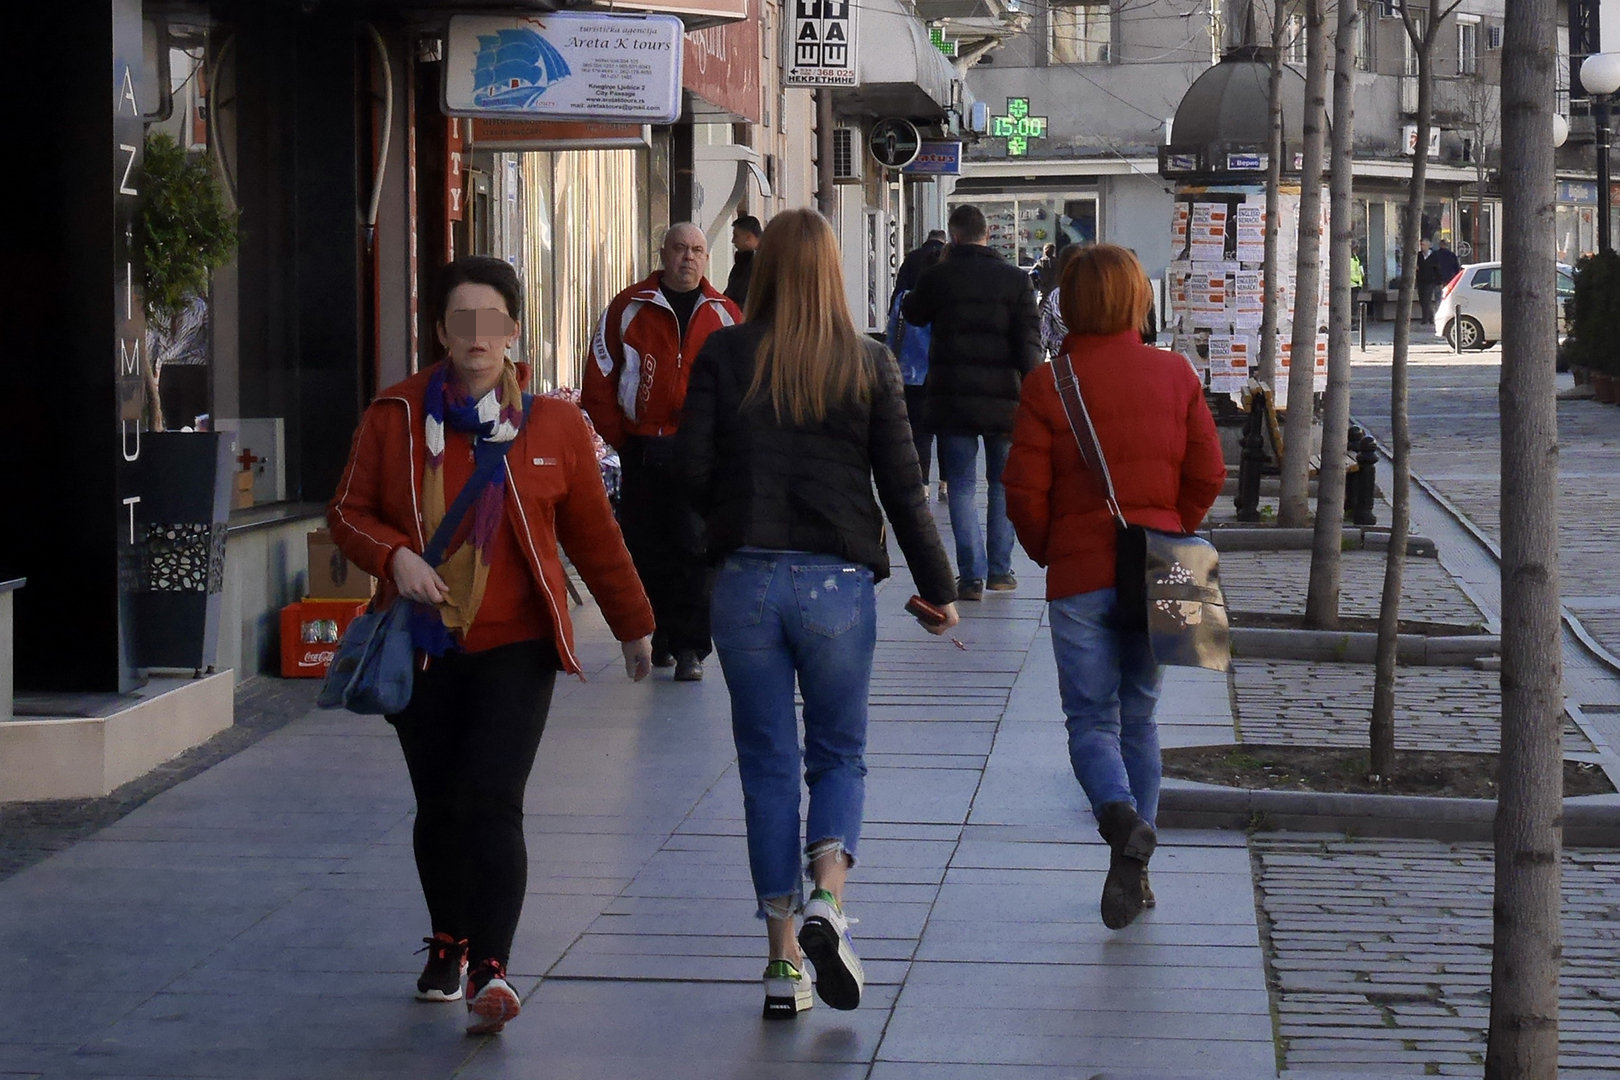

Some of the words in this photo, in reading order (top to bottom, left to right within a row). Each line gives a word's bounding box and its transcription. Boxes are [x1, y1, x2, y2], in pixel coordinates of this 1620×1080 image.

[579, 26, 620, 34] turistička
[622, 27, 658, 37] agencija
[564, 36, 609, 49] Areta
[613, 37, 629, 50] K
[633, 38, 671, 51] tours
[817, 68, 834, 77] 368
[836, 69, 854, 77] 025
[788, 75, 855, 84] НЕКРЕТНИНЕ
[994, 117, 1041, 137] 15:00
[117, 64, 141, 545] AZIMUT
